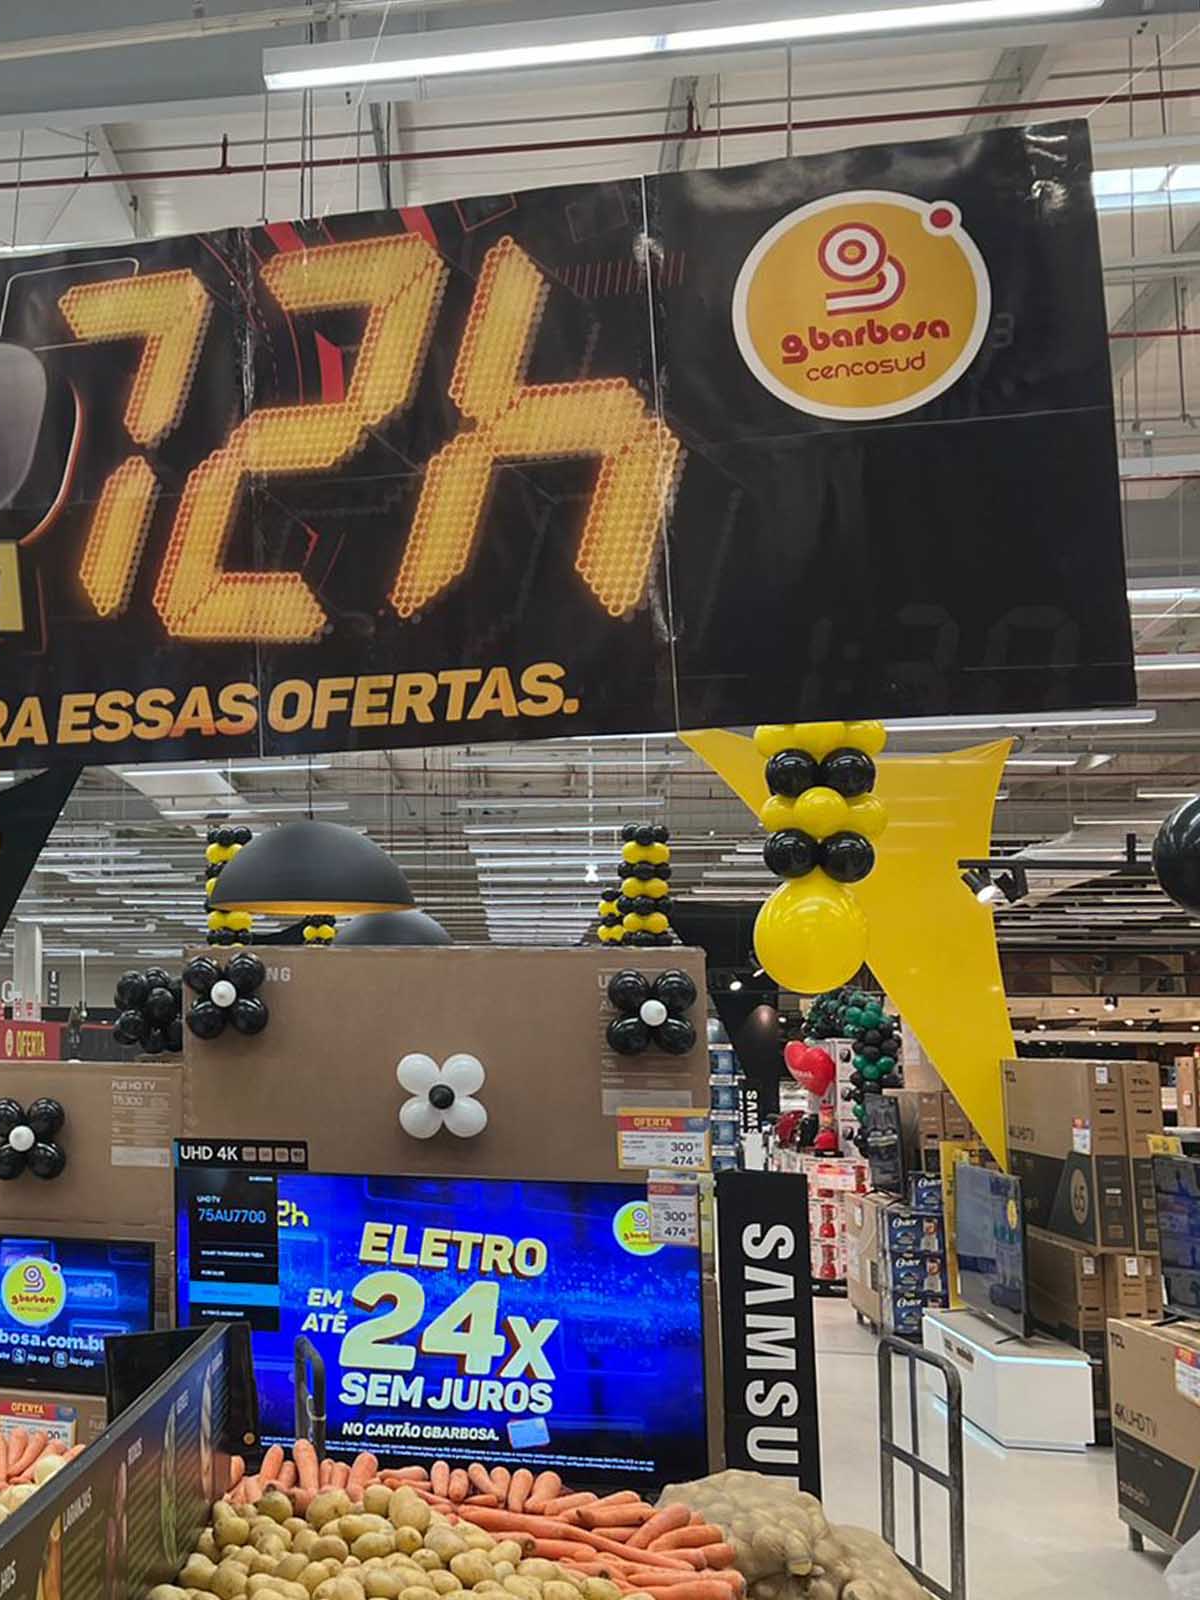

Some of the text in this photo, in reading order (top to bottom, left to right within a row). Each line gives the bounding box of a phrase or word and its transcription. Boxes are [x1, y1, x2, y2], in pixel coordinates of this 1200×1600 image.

[781, 319, 950, 365] gbarbosa
[806, 351, 926, 382] cencosud
[56, 681, 261, 745] ESSAS
[267, 662, 580, 732] OFERTAS.
[180, 1146, 213, 1160] UHD
[217, 1147, 239, 1160] 4K
[670, 1142, 694, 1153] 300
[671, 1156, 694, 1166] 474
[198, 1208, 267, 1224] 75AU7700
[663, 1211, 687, 1222] 300
[664, 1227, 687, 1237] 474
[358, 1221, 549, 1278] ELETRO
[307, 1288, 344, 1308] EM
[301, 1311, 348, 1333] ATÉ
[742, 1223, 800, 1490] SAMSU
[338, 1372, 553, 1414] SEM JUROS
[10, 1401, 45, 1414] OFERTA
[342, 1421, 499, 1441] NO CARTÃO GBARBOSA.
